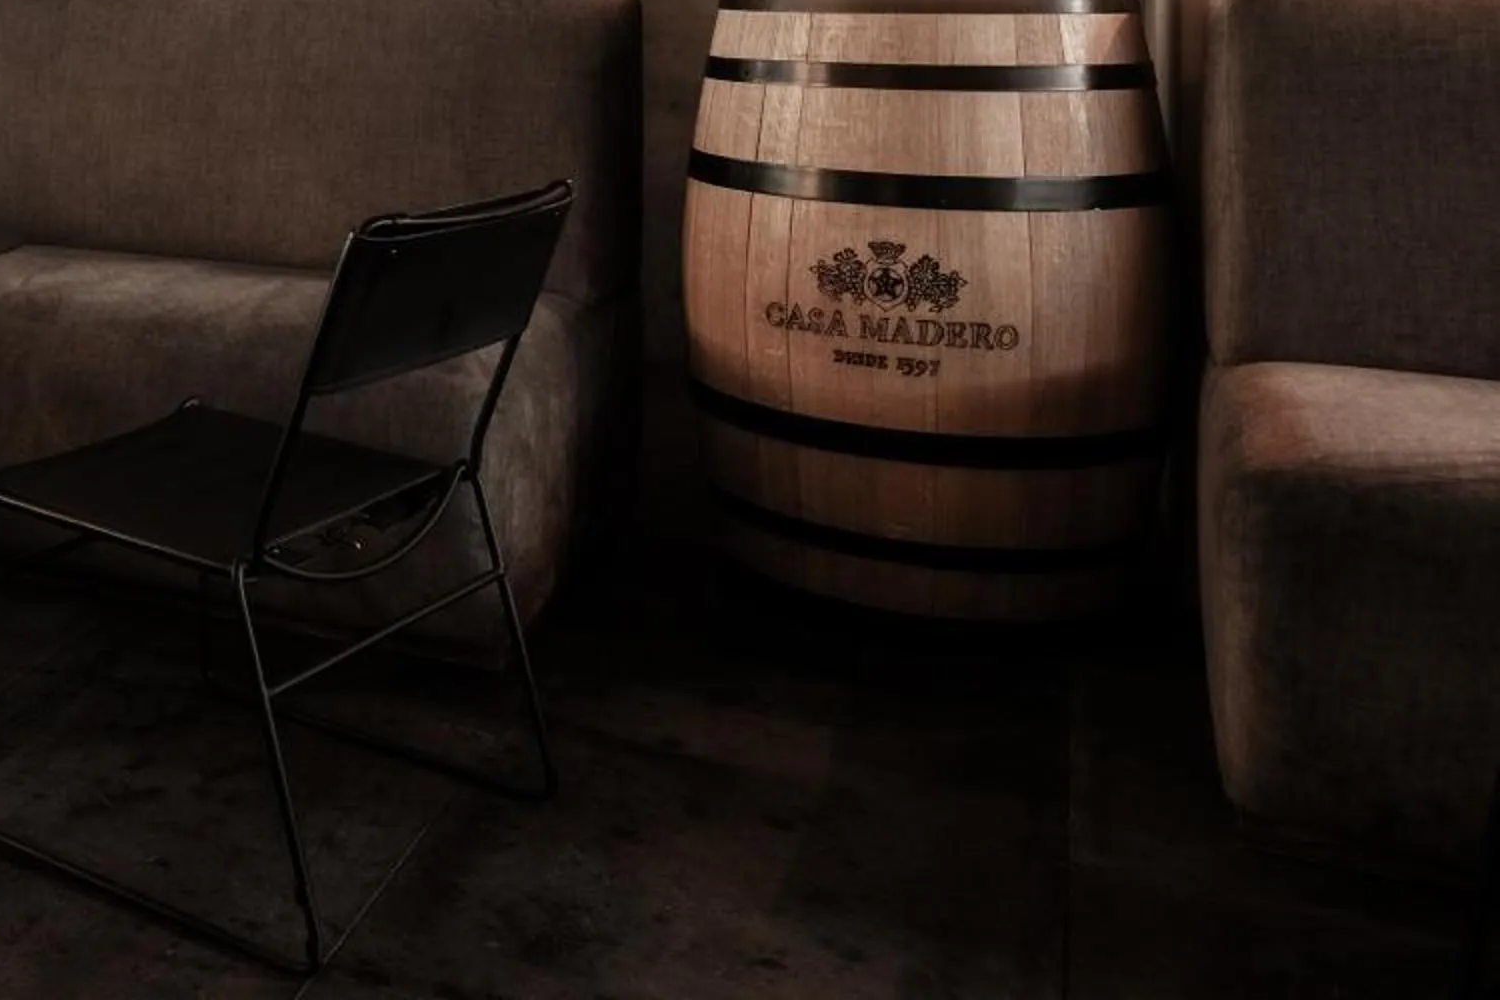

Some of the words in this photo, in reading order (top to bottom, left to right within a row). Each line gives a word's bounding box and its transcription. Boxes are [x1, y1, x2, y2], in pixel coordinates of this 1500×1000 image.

[765, 302, 849, 338] CASA
[859, 315, 1020, 351] MADERO
[896, 357, 940, 377] 1597
